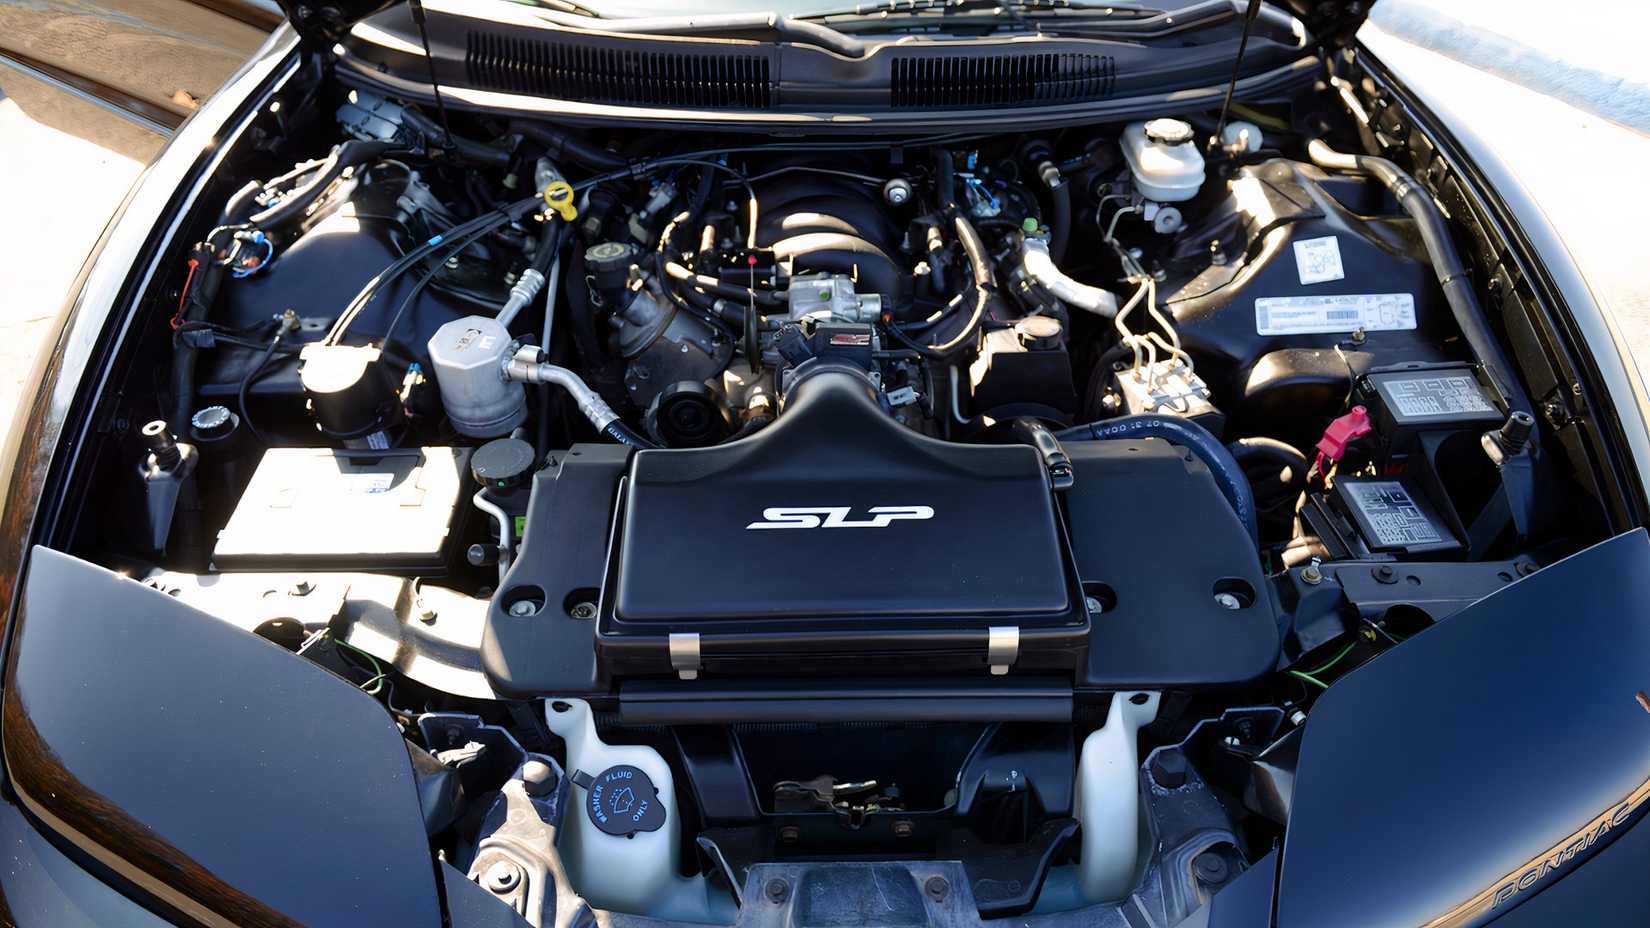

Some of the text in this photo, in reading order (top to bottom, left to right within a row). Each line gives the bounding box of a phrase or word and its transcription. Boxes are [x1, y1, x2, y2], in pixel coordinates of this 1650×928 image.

[745, 505, 935, 530] SLP
[592, 770, 648, 824] WASHER FLUID ONLY
[1491, 802, 1631, 910] PONTIAC
